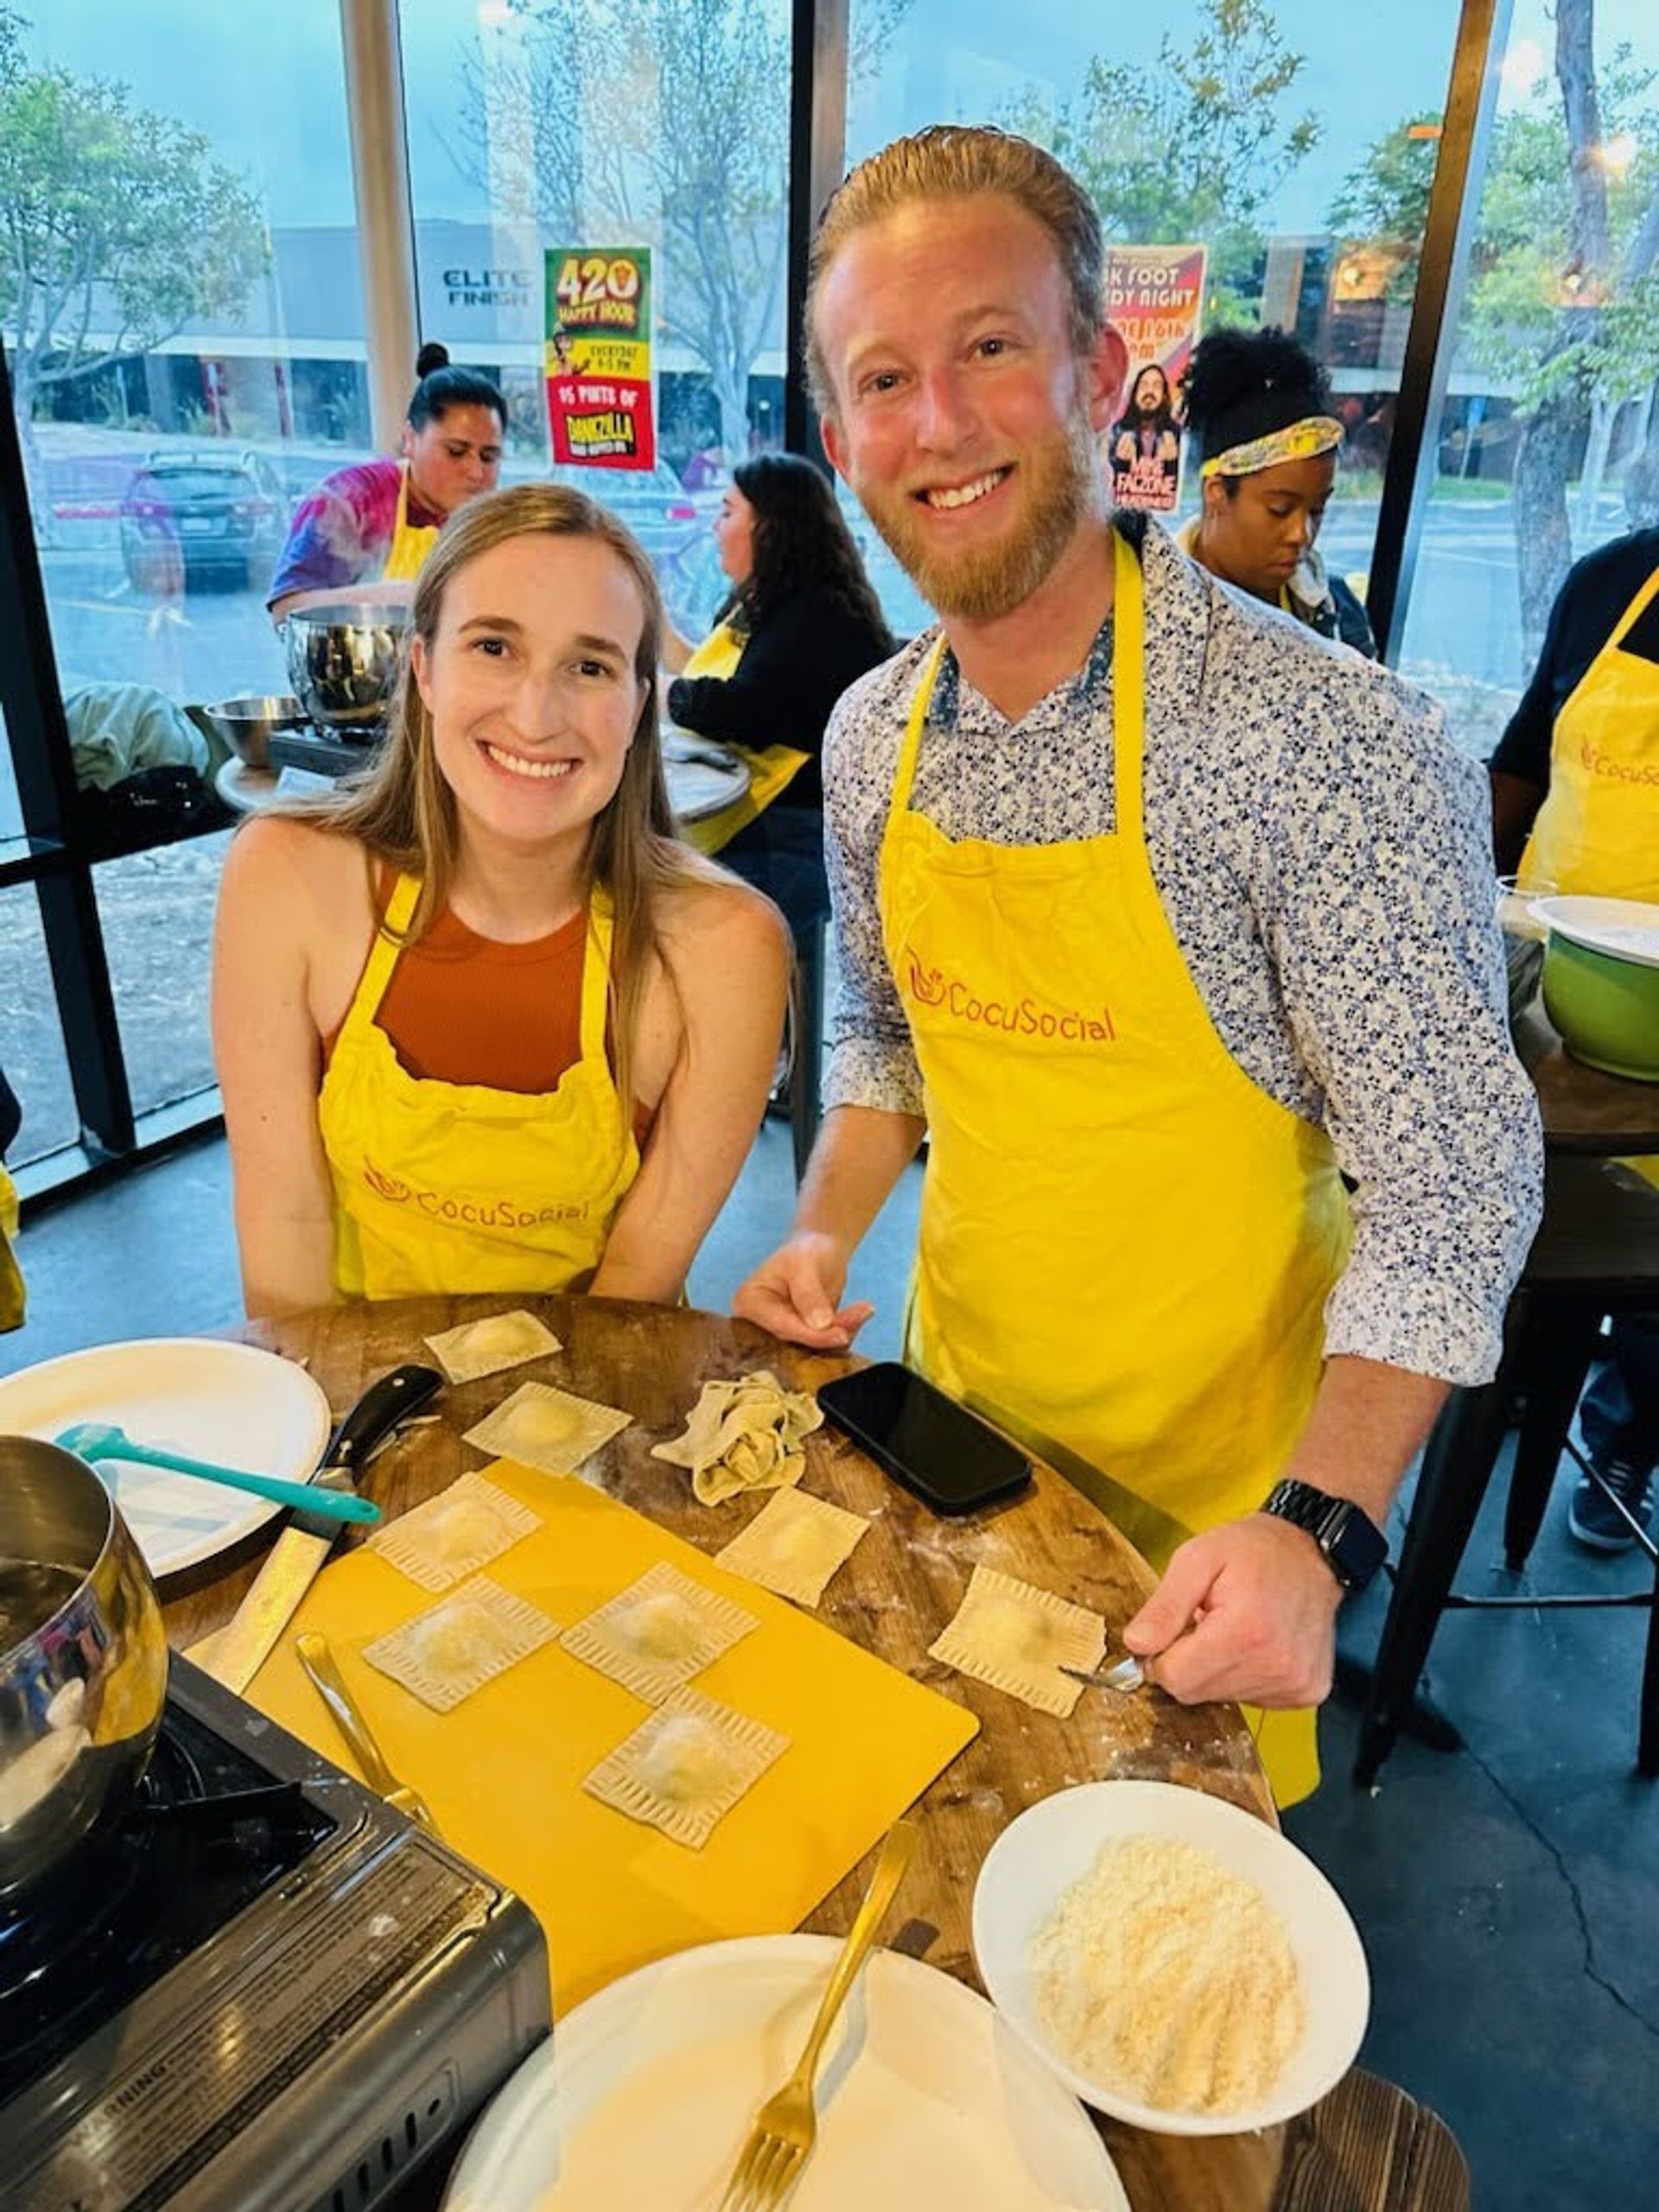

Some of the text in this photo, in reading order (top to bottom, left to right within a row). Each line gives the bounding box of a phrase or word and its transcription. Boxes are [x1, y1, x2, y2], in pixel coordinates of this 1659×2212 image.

[442, 270, 533, 287] ELITE
[557, 257, 639, 307] 420
[1128, 266, 1179, 286] FOOT
[449, 291, 529, 306] FINISH
[1139, 289, 1194, 308] NIGHT
[558, 300, 636, 327] HAPPY HOUR
[578, 385, 617, 405] PINTS
[620, 388, 638, 407] OF
[950, 982, 1116, 1042] CocuSocial
[416, 1192, 589, 1228] CocuSocial
